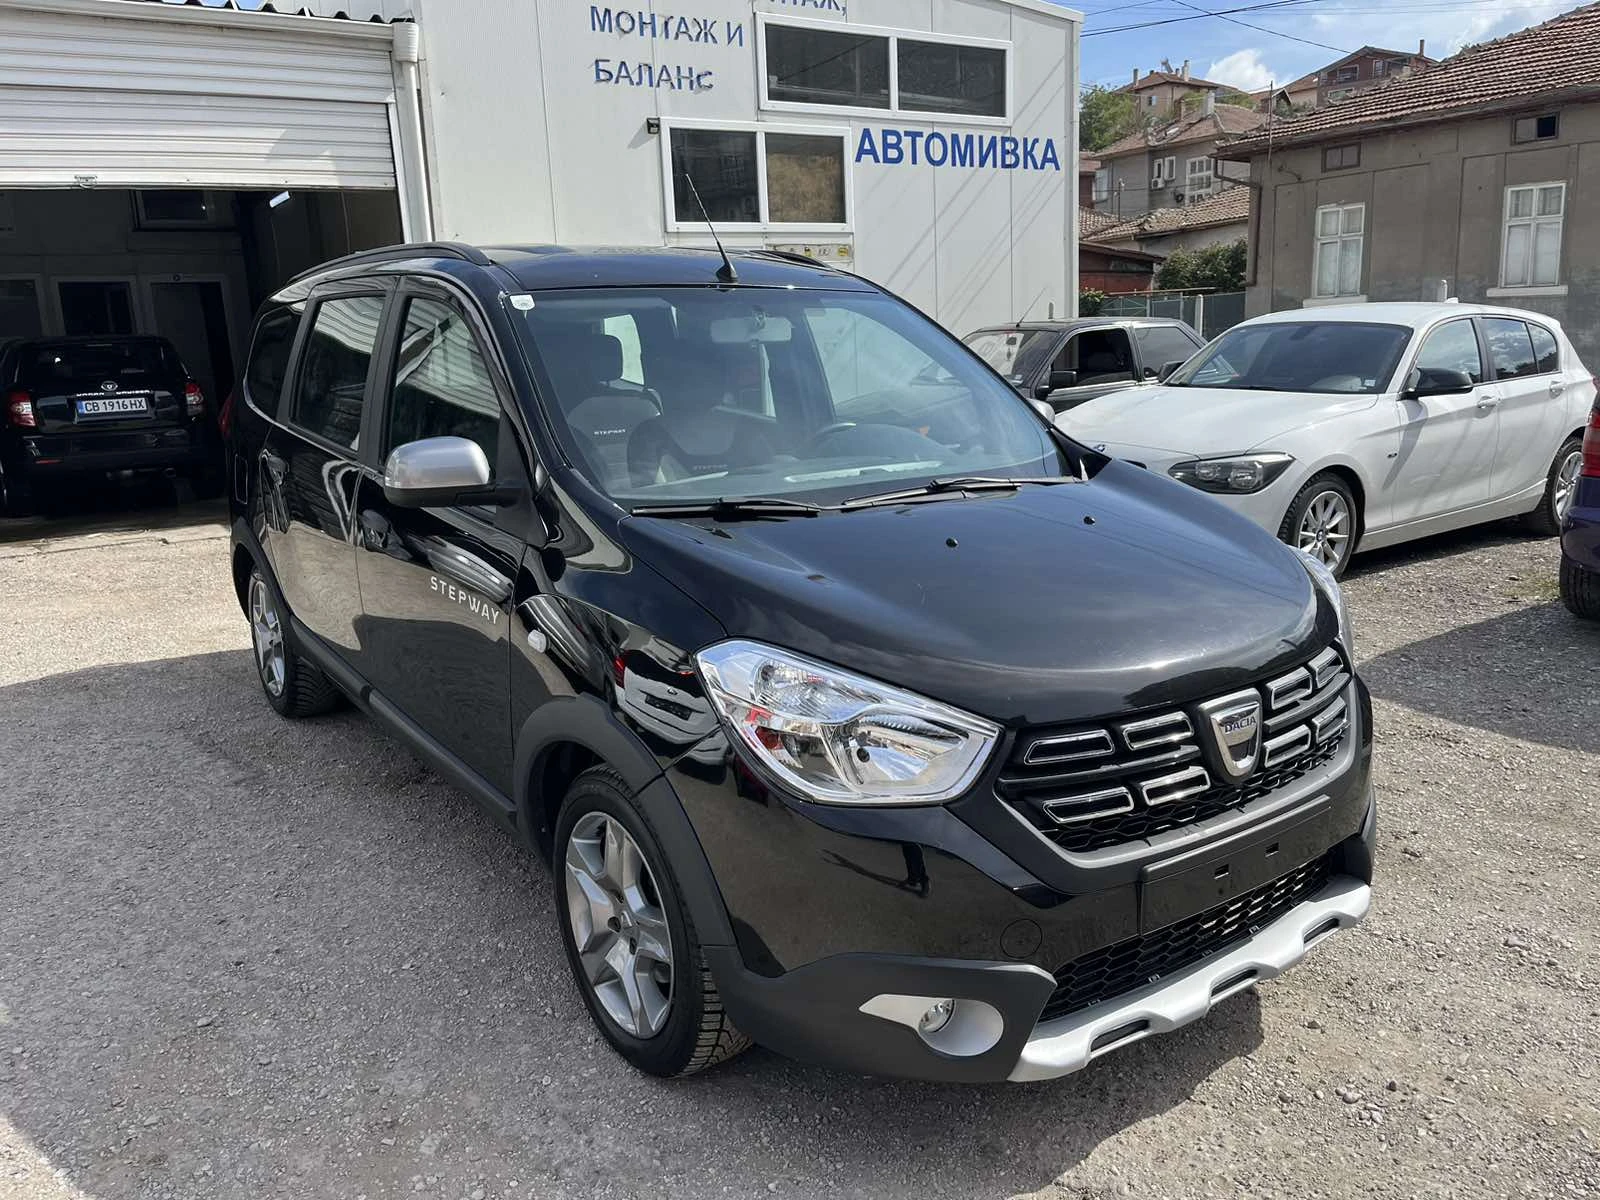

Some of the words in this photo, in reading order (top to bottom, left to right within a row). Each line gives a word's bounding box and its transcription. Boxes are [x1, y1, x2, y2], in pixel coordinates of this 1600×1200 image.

[590, 6, 718, 44] МОНТАЖ
[727, 21, 743, 47] И
[594, 58, 713, 91] БАЛАНС
[855, 127, 1060, 171] АВТОМИВКА
[102, 400, 129, 411] 1916
[129, 399, 145, 410] HX
[430, 575, 500, 625] STEPWAY
[1224, 716, 1257, 733] DACIA
